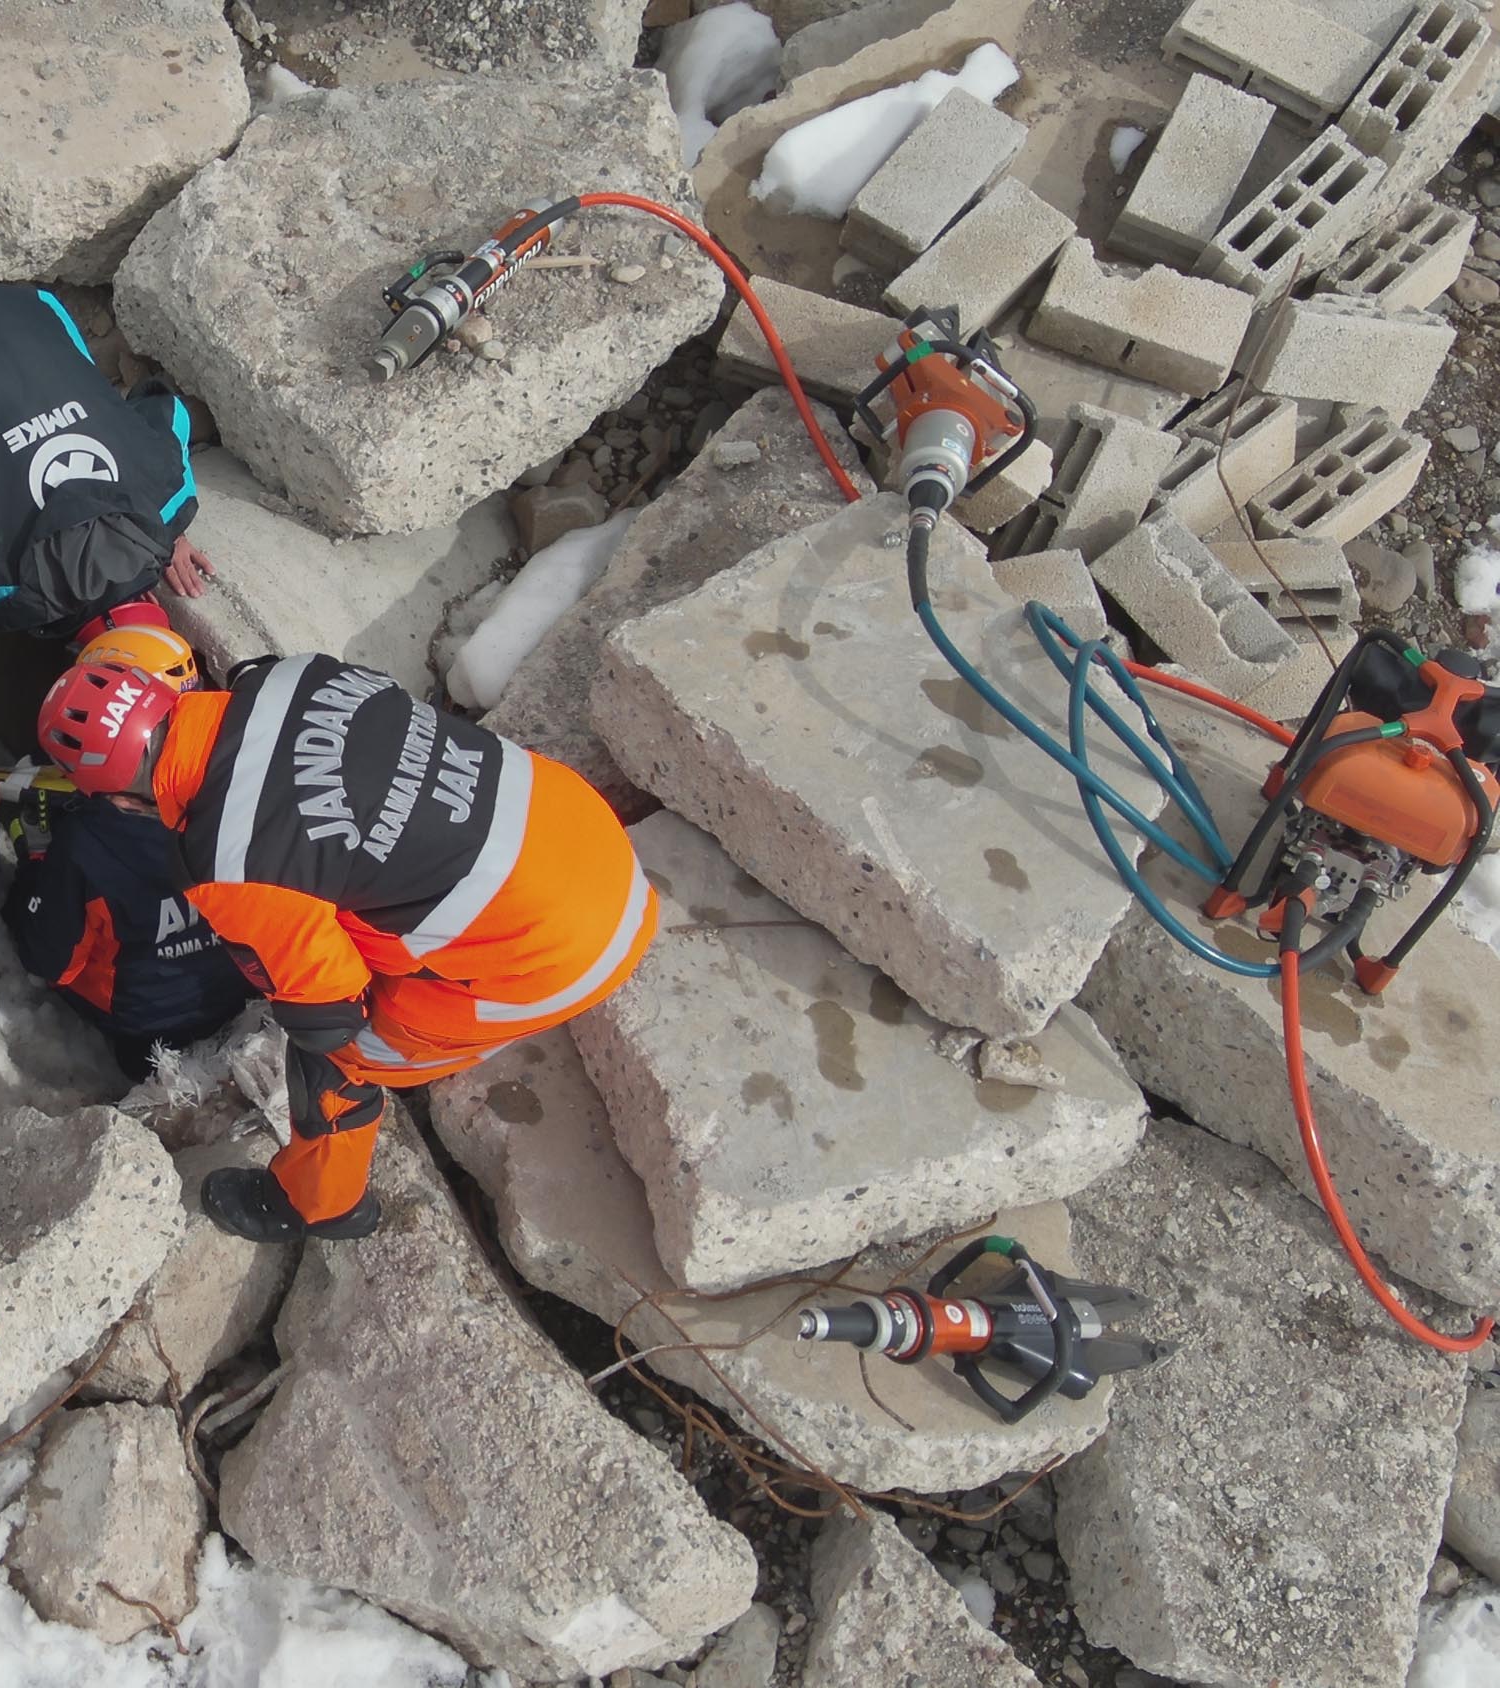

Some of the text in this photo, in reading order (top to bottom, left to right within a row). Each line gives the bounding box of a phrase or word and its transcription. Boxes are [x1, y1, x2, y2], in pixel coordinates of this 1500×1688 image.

[2, 400, 88, 454] UMKE
[100, 680, 143, 738] JAK
[431, 736, 484, 823] JAK
[362, 776, 422, 863] ARAMA
[157, 937, 202, 960] ARAMA
